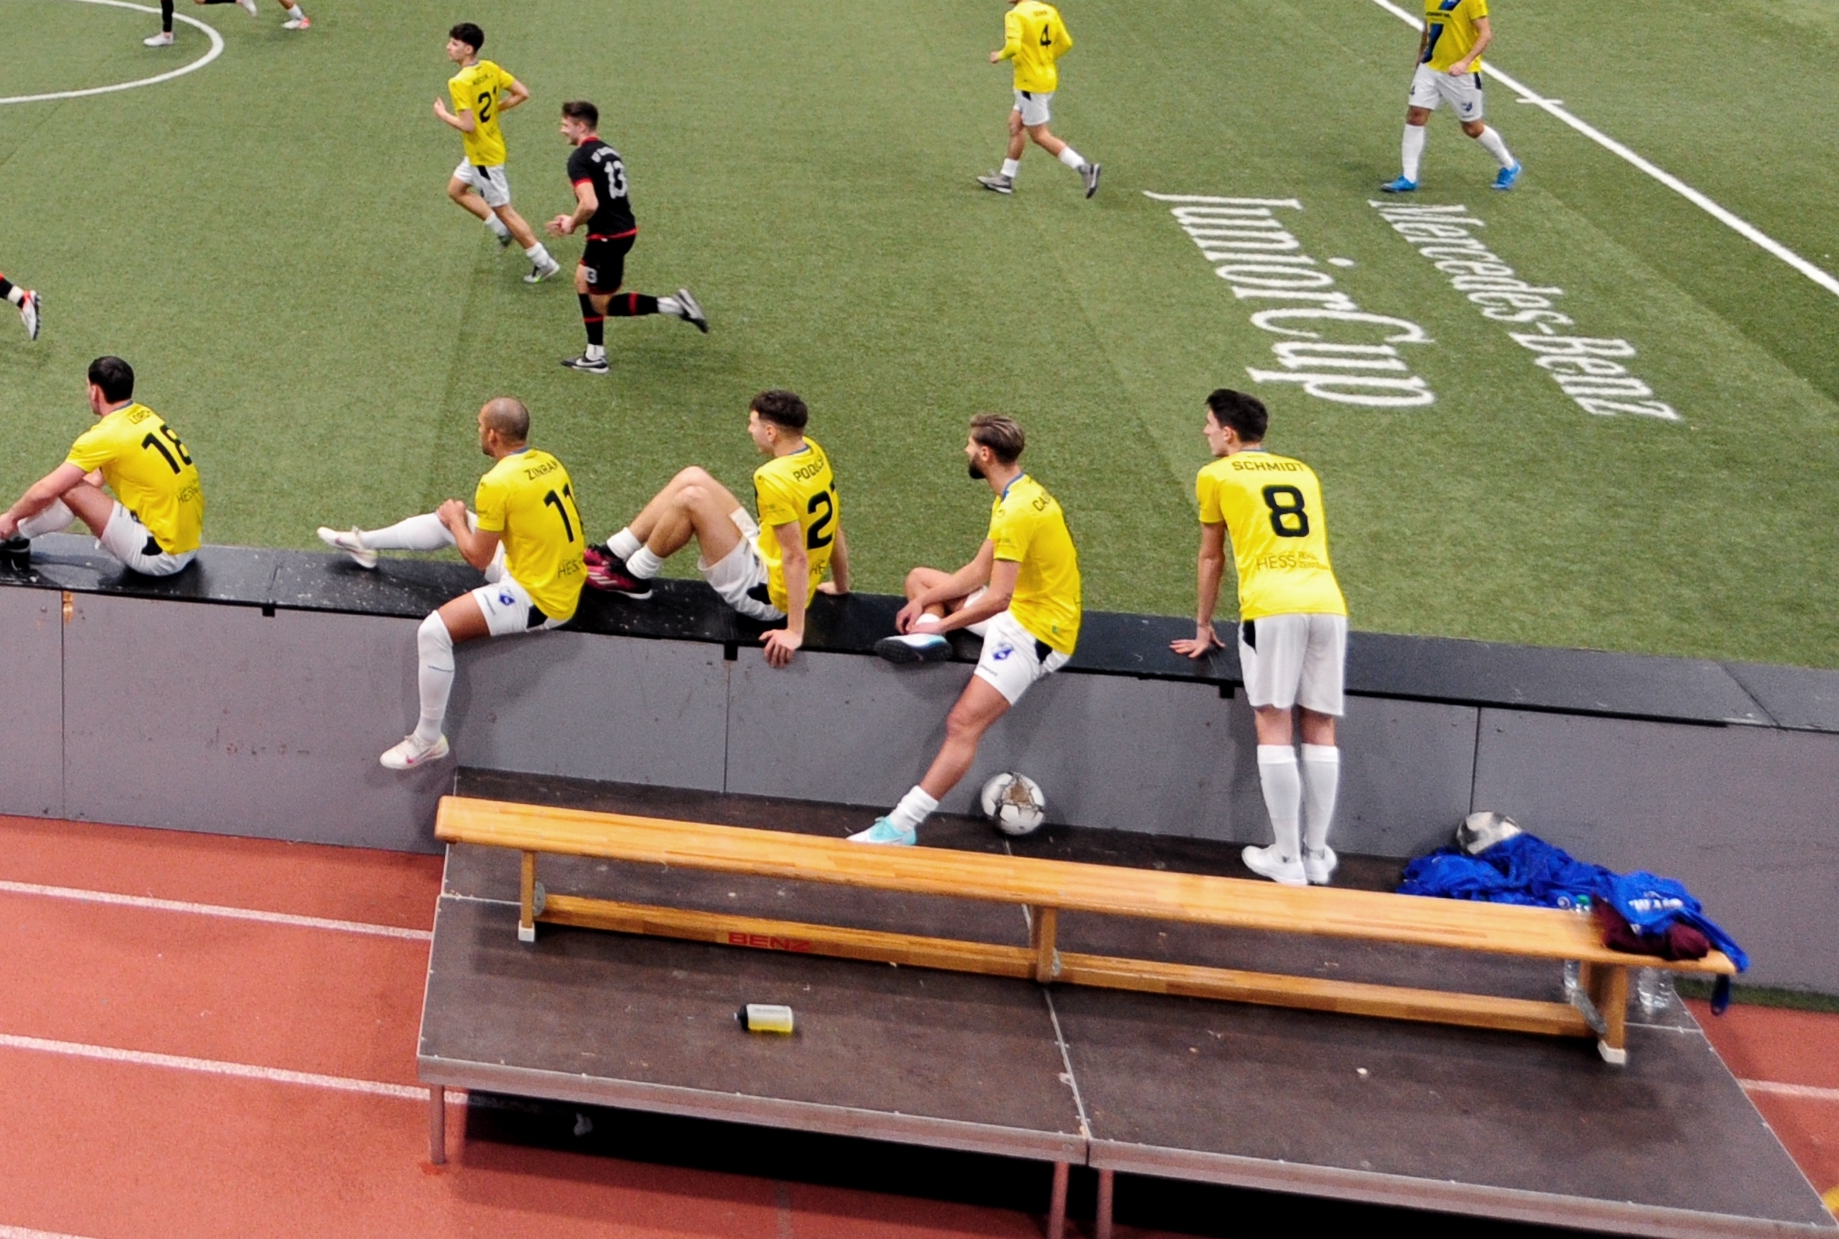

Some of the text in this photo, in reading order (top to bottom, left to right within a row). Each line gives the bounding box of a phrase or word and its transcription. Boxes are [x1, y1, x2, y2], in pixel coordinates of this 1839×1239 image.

[1040, 23, 1052, 49] 4
[604, 160, 629, 199] 13
[1142, 190, 1436, 407] Junior Cup
[1367, 198, 1682, 421] Mercedes-Benz
[141, 423, 192, 475] 18
[1231, 461, 1304, 473] SCHMIDT
[1262, 484, 1310, 537] 8
[1257, 553, 1297, 571] HESS
[728, 931, 813, 953] BENZ
